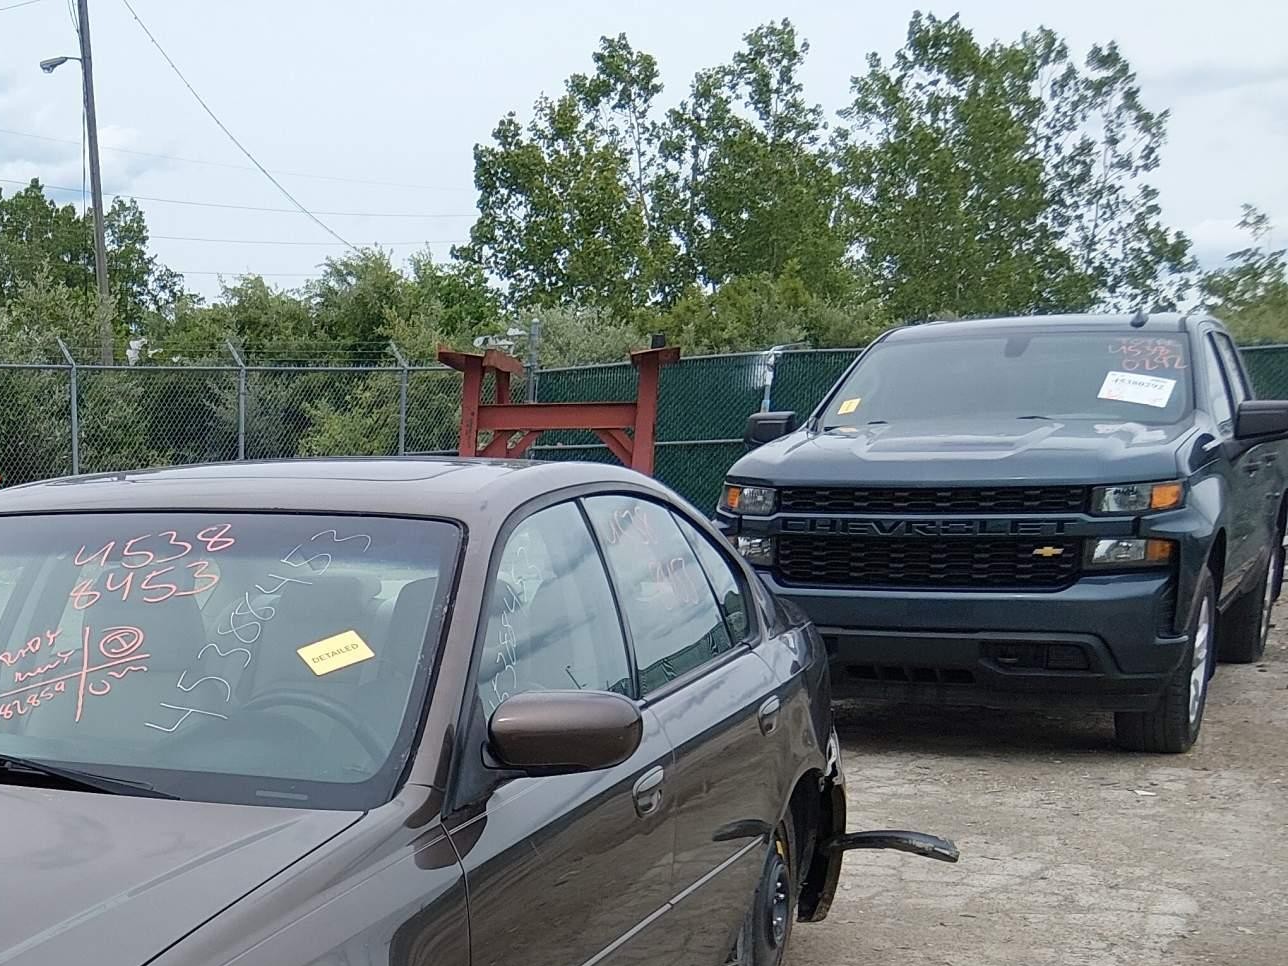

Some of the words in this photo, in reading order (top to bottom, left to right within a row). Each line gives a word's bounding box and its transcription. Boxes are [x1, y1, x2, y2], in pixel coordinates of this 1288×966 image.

[780, 517, 1079, 537] CHEVROLET
[74, 523, 235, 567] 4538
[69, 560, 221, 611] 8453
[312, 643, 359, 663] DETAILED
